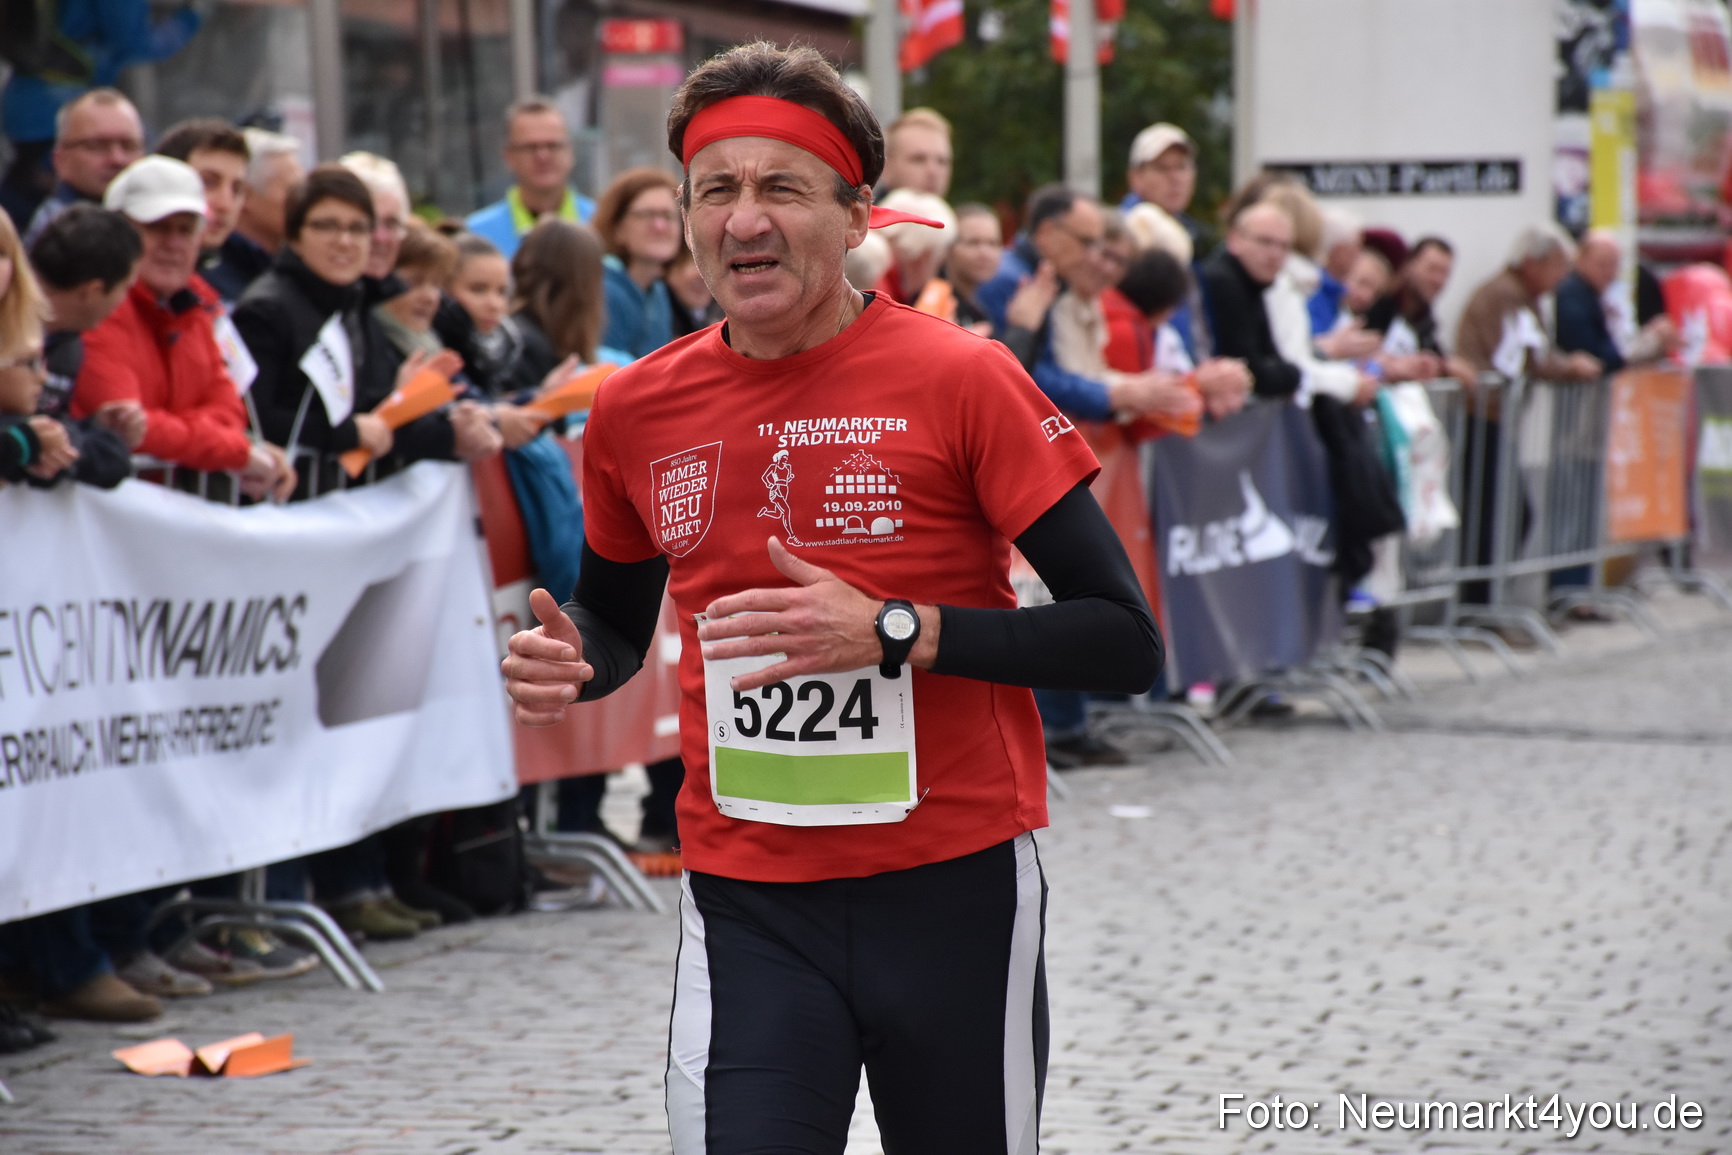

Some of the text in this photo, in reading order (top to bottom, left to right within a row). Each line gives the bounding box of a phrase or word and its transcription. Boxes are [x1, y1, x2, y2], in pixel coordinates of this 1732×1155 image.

[757, 417, 908, 437] 11. NEUMARKTER
[777, 431, 882, 448] STADTLAUF
[681, 454, 698, 464] Jahre
[661, 460, 708, 488] IMMER
[658, 476, 708, 503] WIEDER
[660, 493, 703, 527] NEU
[822, 500, 903, 513] 19.09.2010
[661, 519, 702, 544] MARKT
[804, 535, 905, 547] www.stadtlauf-neumarkt.de
[732, 677, 879, 741] 5224
[718, 726, 726, 738] S
